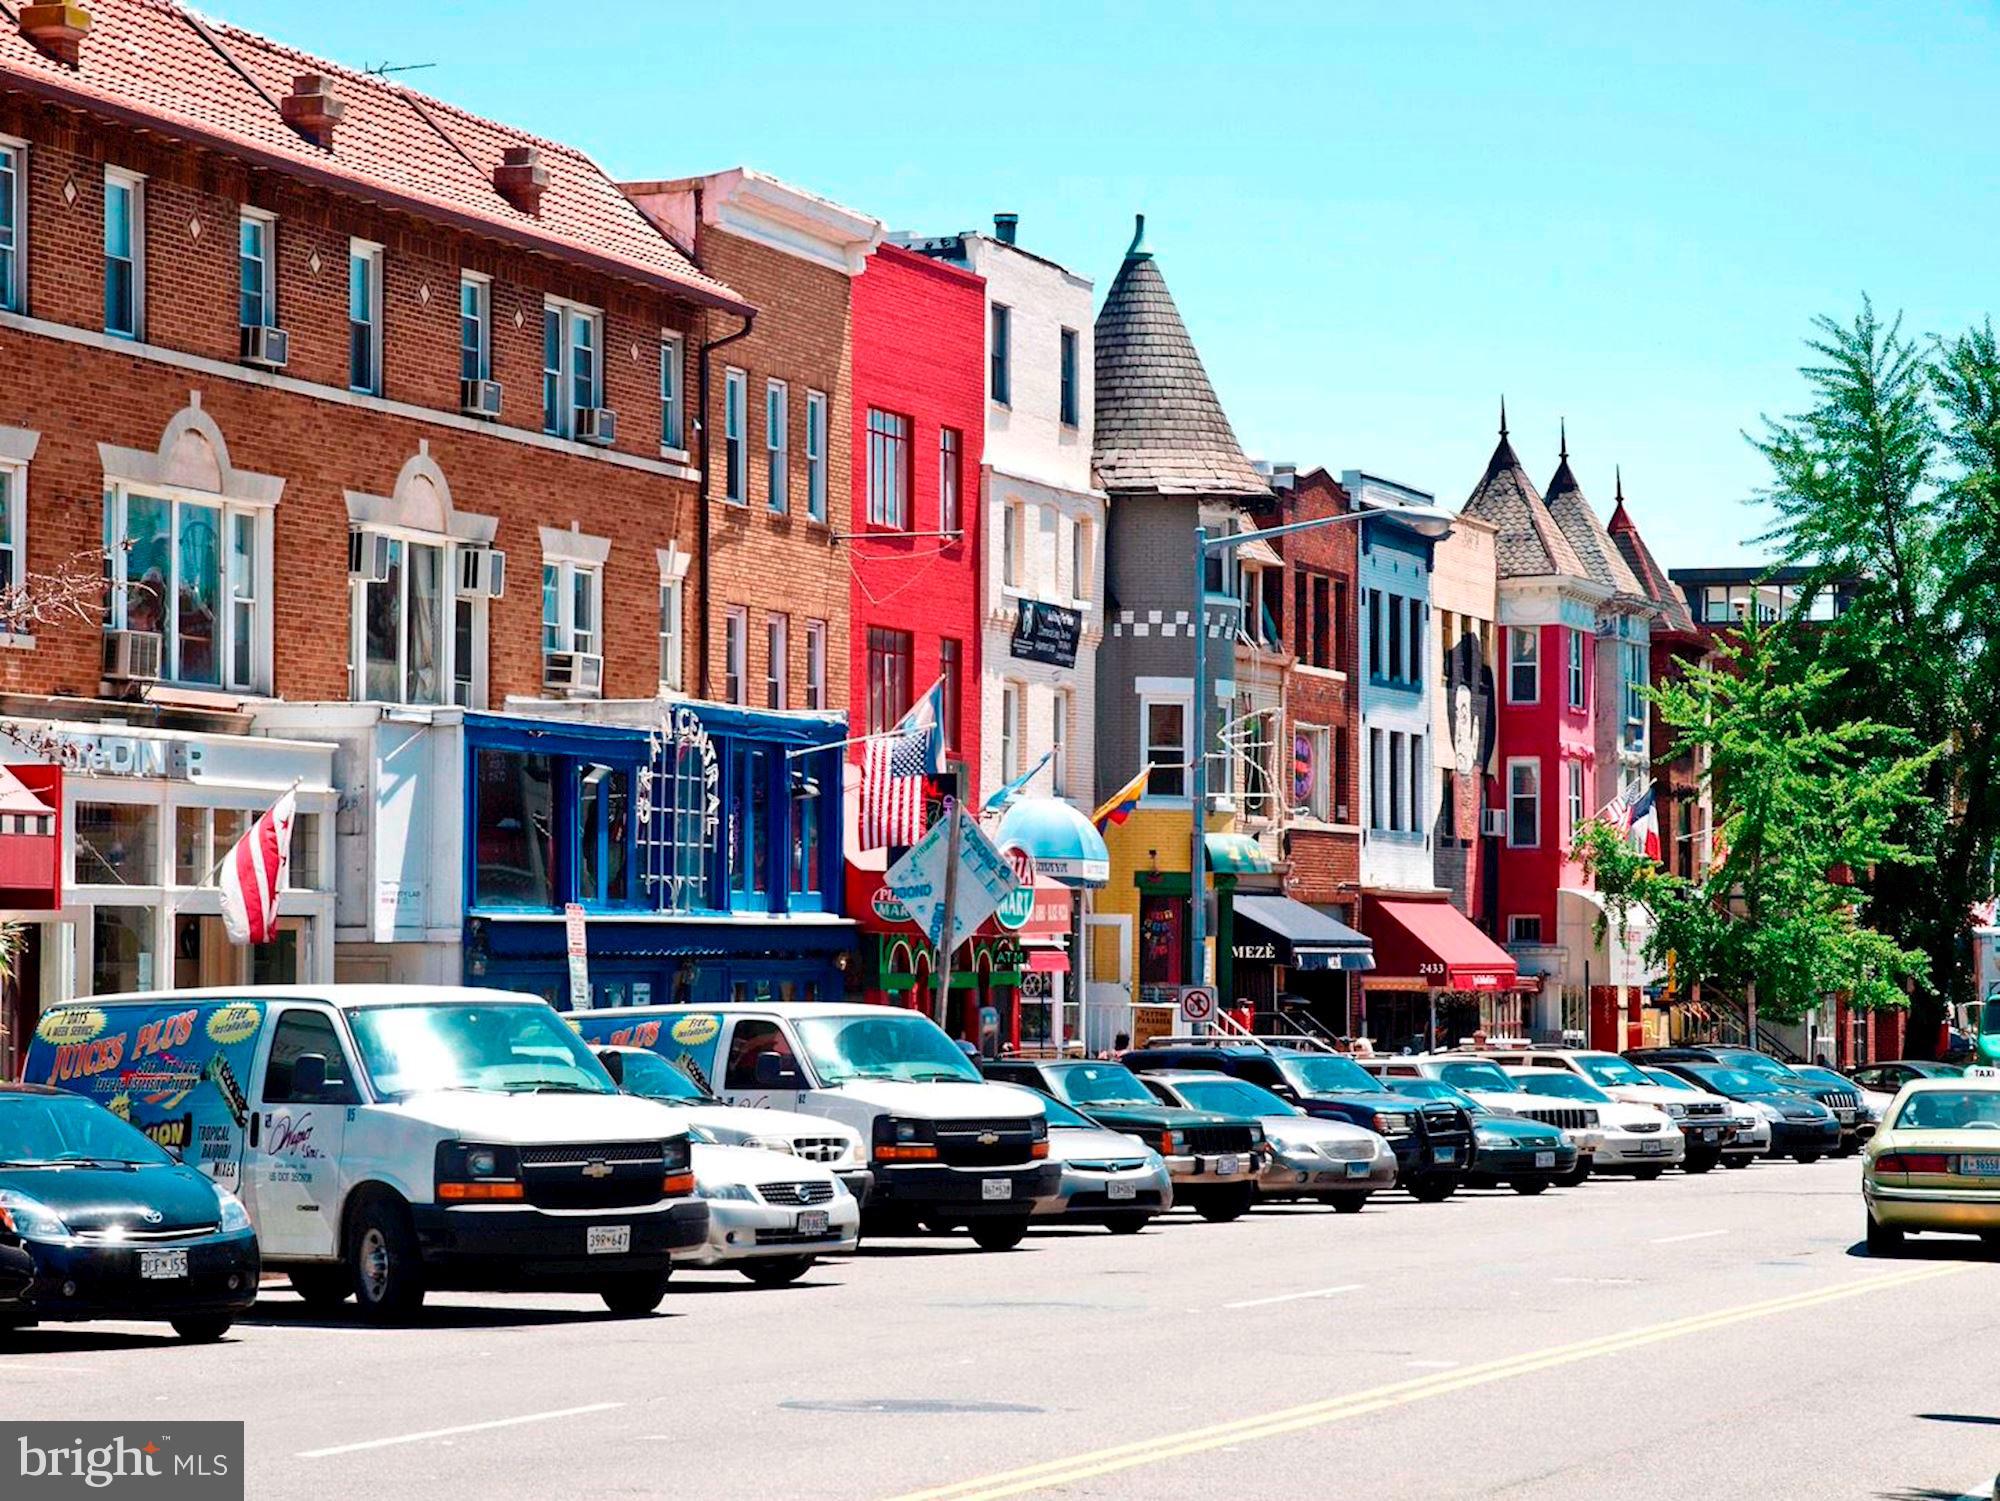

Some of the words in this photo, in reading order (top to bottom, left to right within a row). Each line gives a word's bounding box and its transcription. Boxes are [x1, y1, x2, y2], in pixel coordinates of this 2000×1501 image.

[879, 903, 912, 918] MAR
[996, 951, 1024, 963] ATM
[1419, 963, 1444, 974] 2433
[227, 1009, 249, 1021] Free
[46, 1033, 127, 1085] JUICES
[130, 1009, 199, 1061] PLUS
[1974, 1069, 1996, 1078] TAXI
